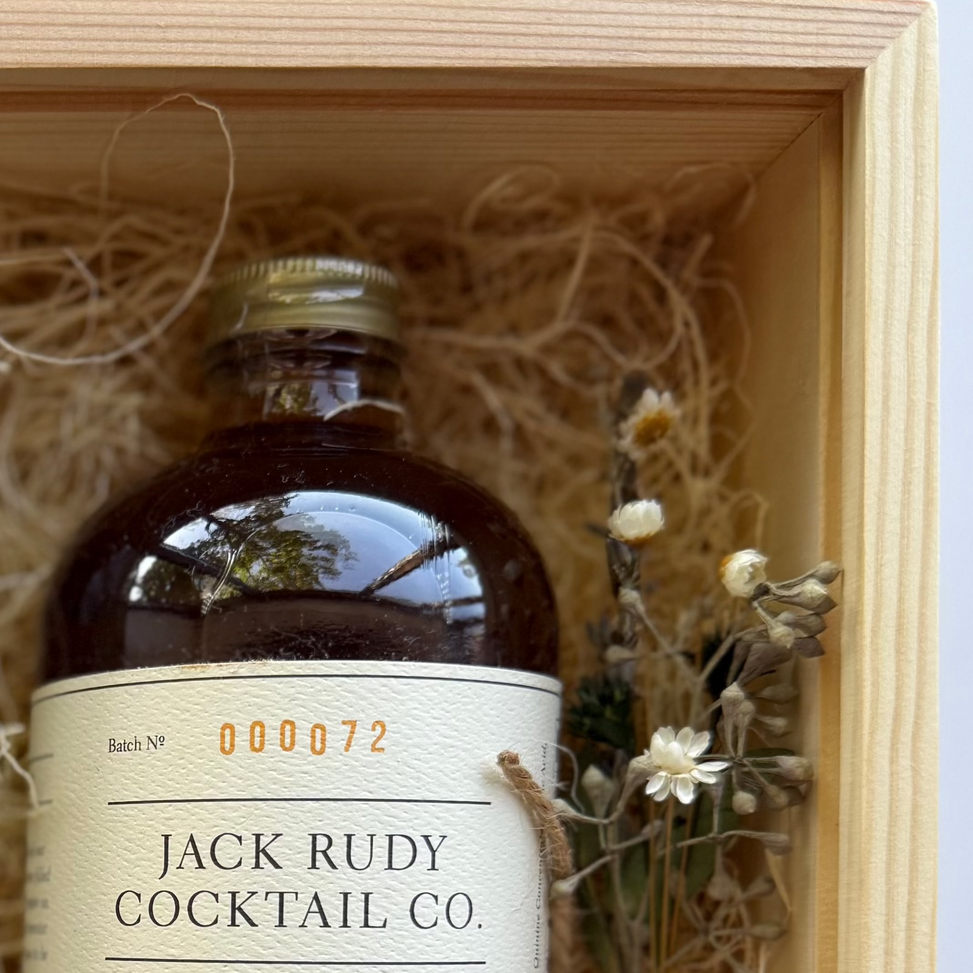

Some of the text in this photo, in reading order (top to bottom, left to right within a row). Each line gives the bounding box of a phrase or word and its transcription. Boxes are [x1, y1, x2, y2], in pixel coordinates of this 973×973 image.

[108, 735, 142, 753] Batch
[219, 718, 387, 756] 000072
[158, 832, 447, 880] JACK RUDY
[115, 889, 483, 930] COCKTAIL CO.
